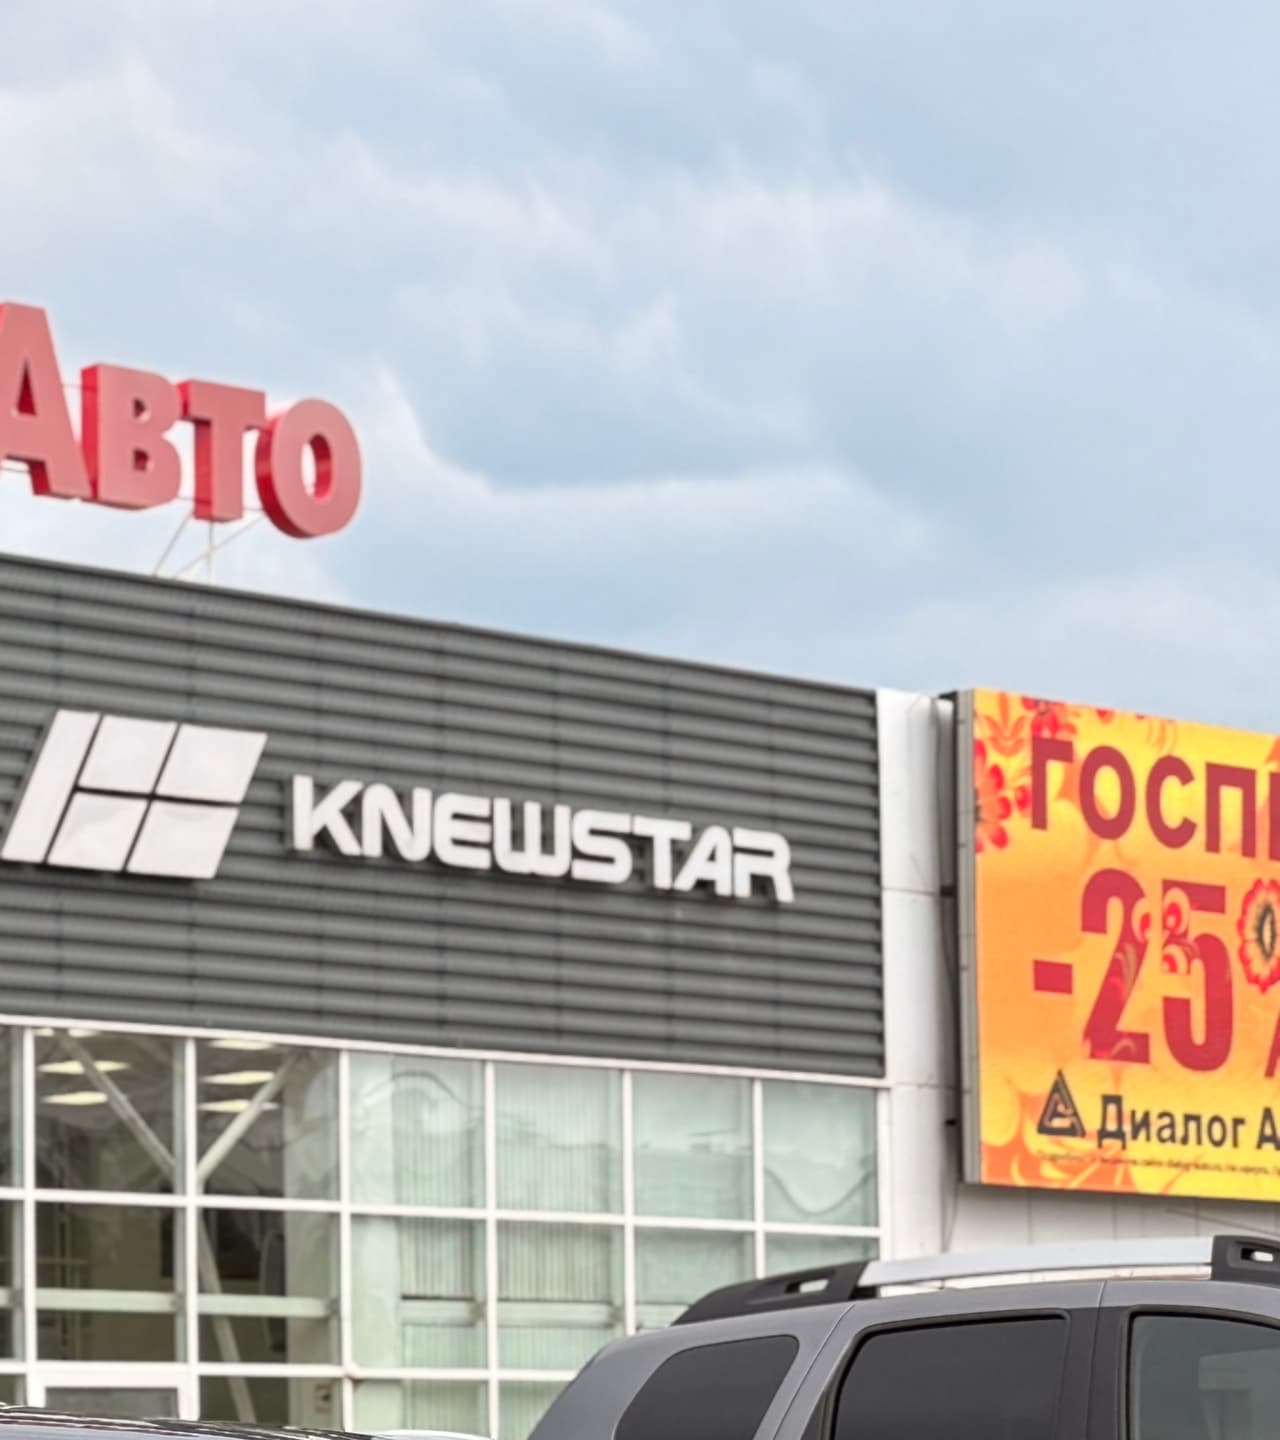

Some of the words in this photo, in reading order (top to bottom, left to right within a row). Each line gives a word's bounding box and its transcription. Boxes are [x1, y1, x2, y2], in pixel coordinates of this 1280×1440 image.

[292, 774, 795, 903] KNEWSTAR
[1030, 734, 1280, 862] ГОСП
[1097, 1093, 1246, 1150] Диалог
